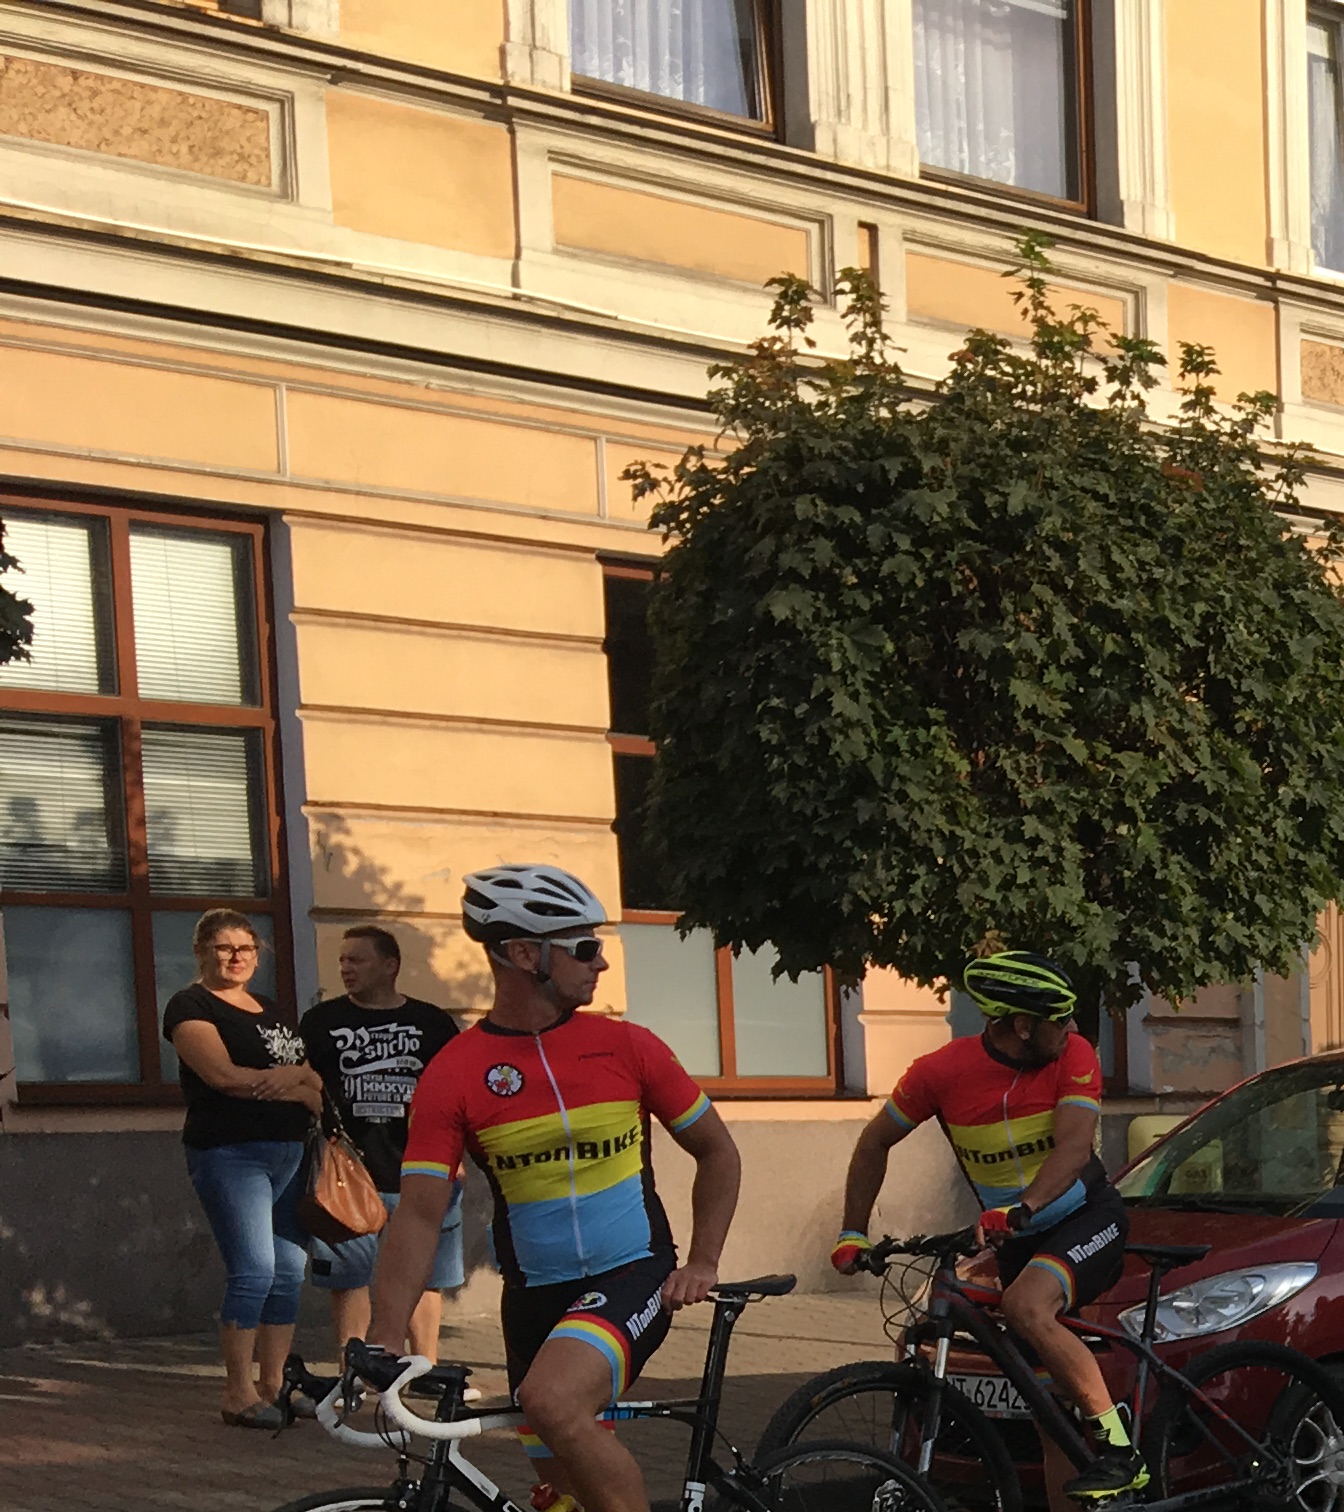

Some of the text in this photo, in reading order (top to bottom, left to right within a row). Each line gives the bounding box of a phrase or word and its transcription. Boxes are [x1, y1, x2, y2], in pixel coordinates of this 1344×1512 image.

[329, 1027, 420, 1061] Psycho
[495, 1125, 640, 1170] NTonBIKE
[1067, 1222, 1121, 1264] NTonBIKE
[626, 1284, 664, 1340] NTonBI
